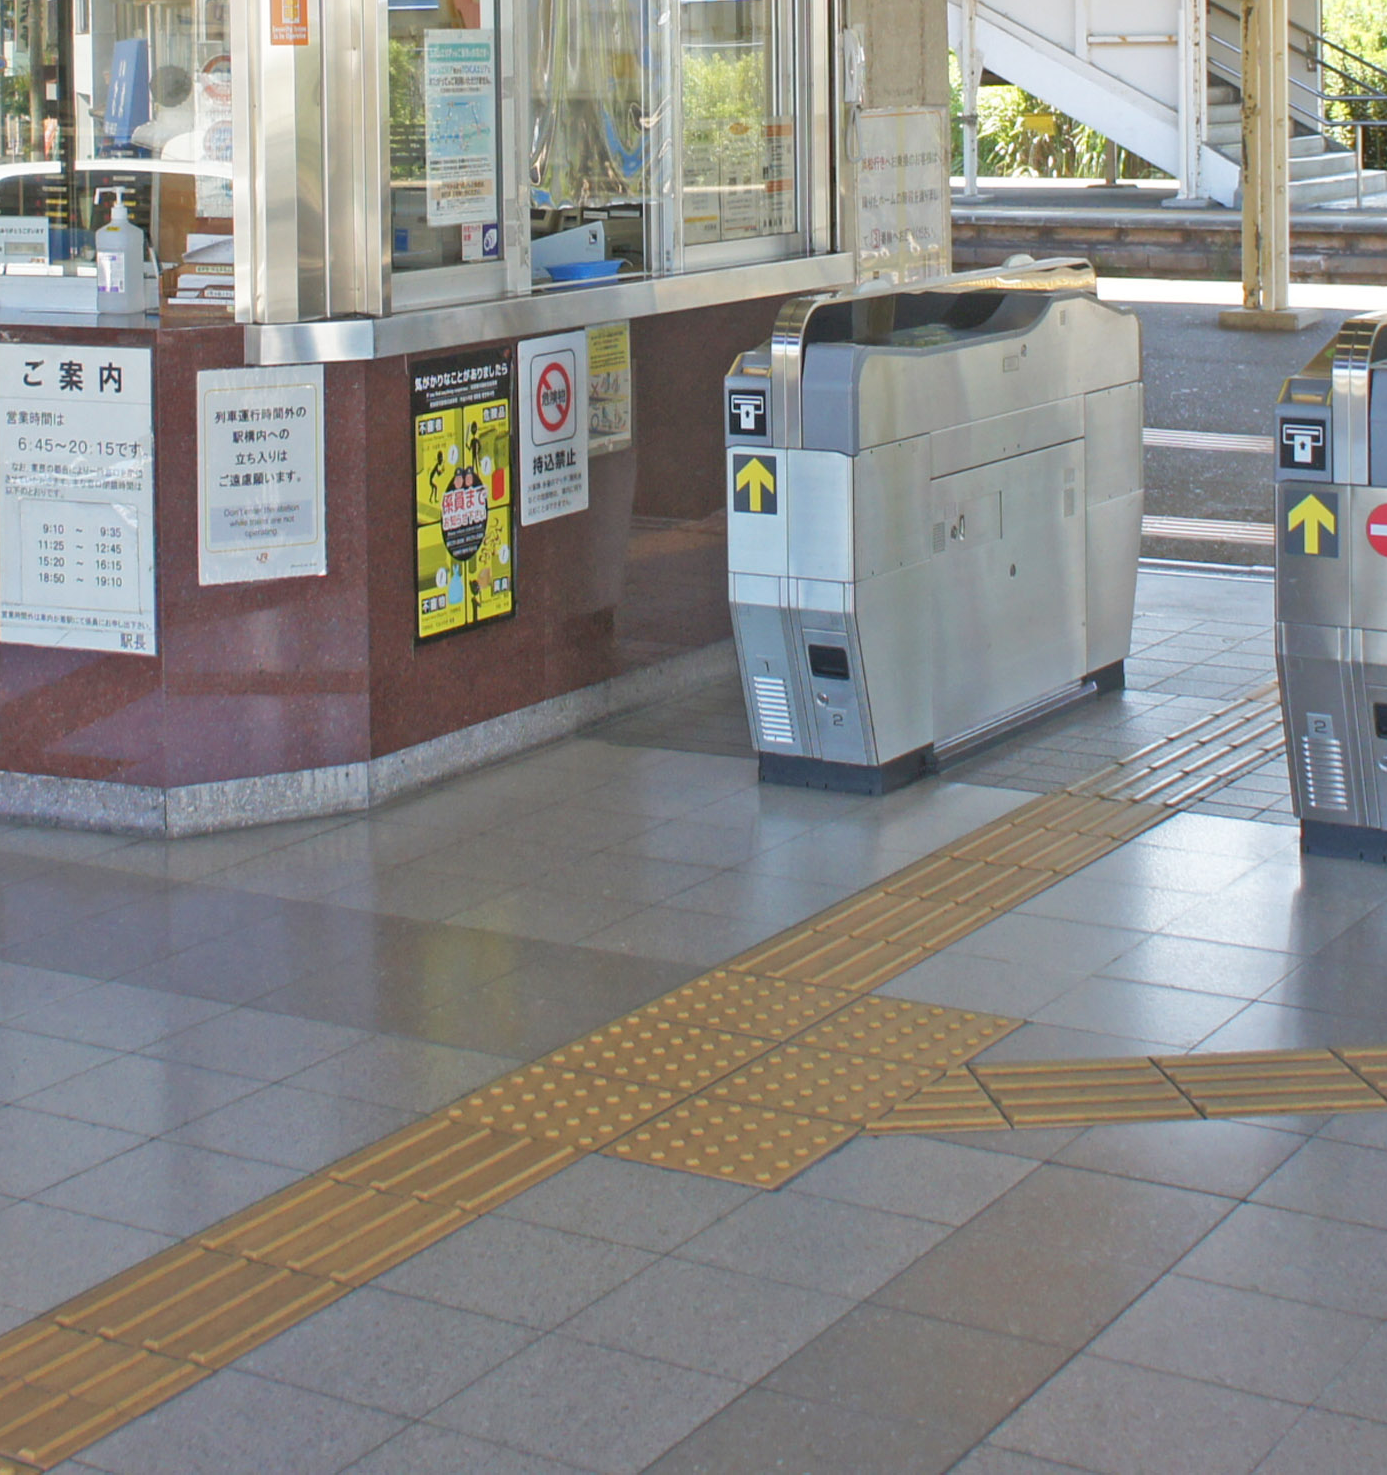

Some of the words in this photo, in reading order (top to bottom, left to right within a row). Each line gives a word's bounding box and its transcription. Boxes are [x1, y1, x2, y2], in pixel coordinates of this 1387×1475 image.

[23, 360, 123, 393] ご案内
[414, 362, 508, 392] 気がかりなことがありましたら
[6, 411, 65, 426] 営業時間は
[215, 406, 307, 425] 列車運行時間外の
[232, 428, 291, 444] 駅構内への
[234, 449, 289, 465] 立ち入りは
[533, 448, 576, 475] 持込禁止
[219, 470, 303, 489] ご遠慮願います。
[442, 486, 487, 515] 係員まで
[43, 524, 64, 535] 9:10
[100, 527, 121, 538] 9:35
[38, 539, 65, 551] 11:25
[95, 543, 122, 554] 12:45
[38, 556, 65, 567] 15:20
[96, 559, 122, 571] 16:15
[39, 572, 65, 584] 18:50
[96, 576, 122, 587] 19:10
[120, 632, 146, 650] 駅長
[832, 713, 844, 727] 2
[1313, 719, 1329, 734] 2
